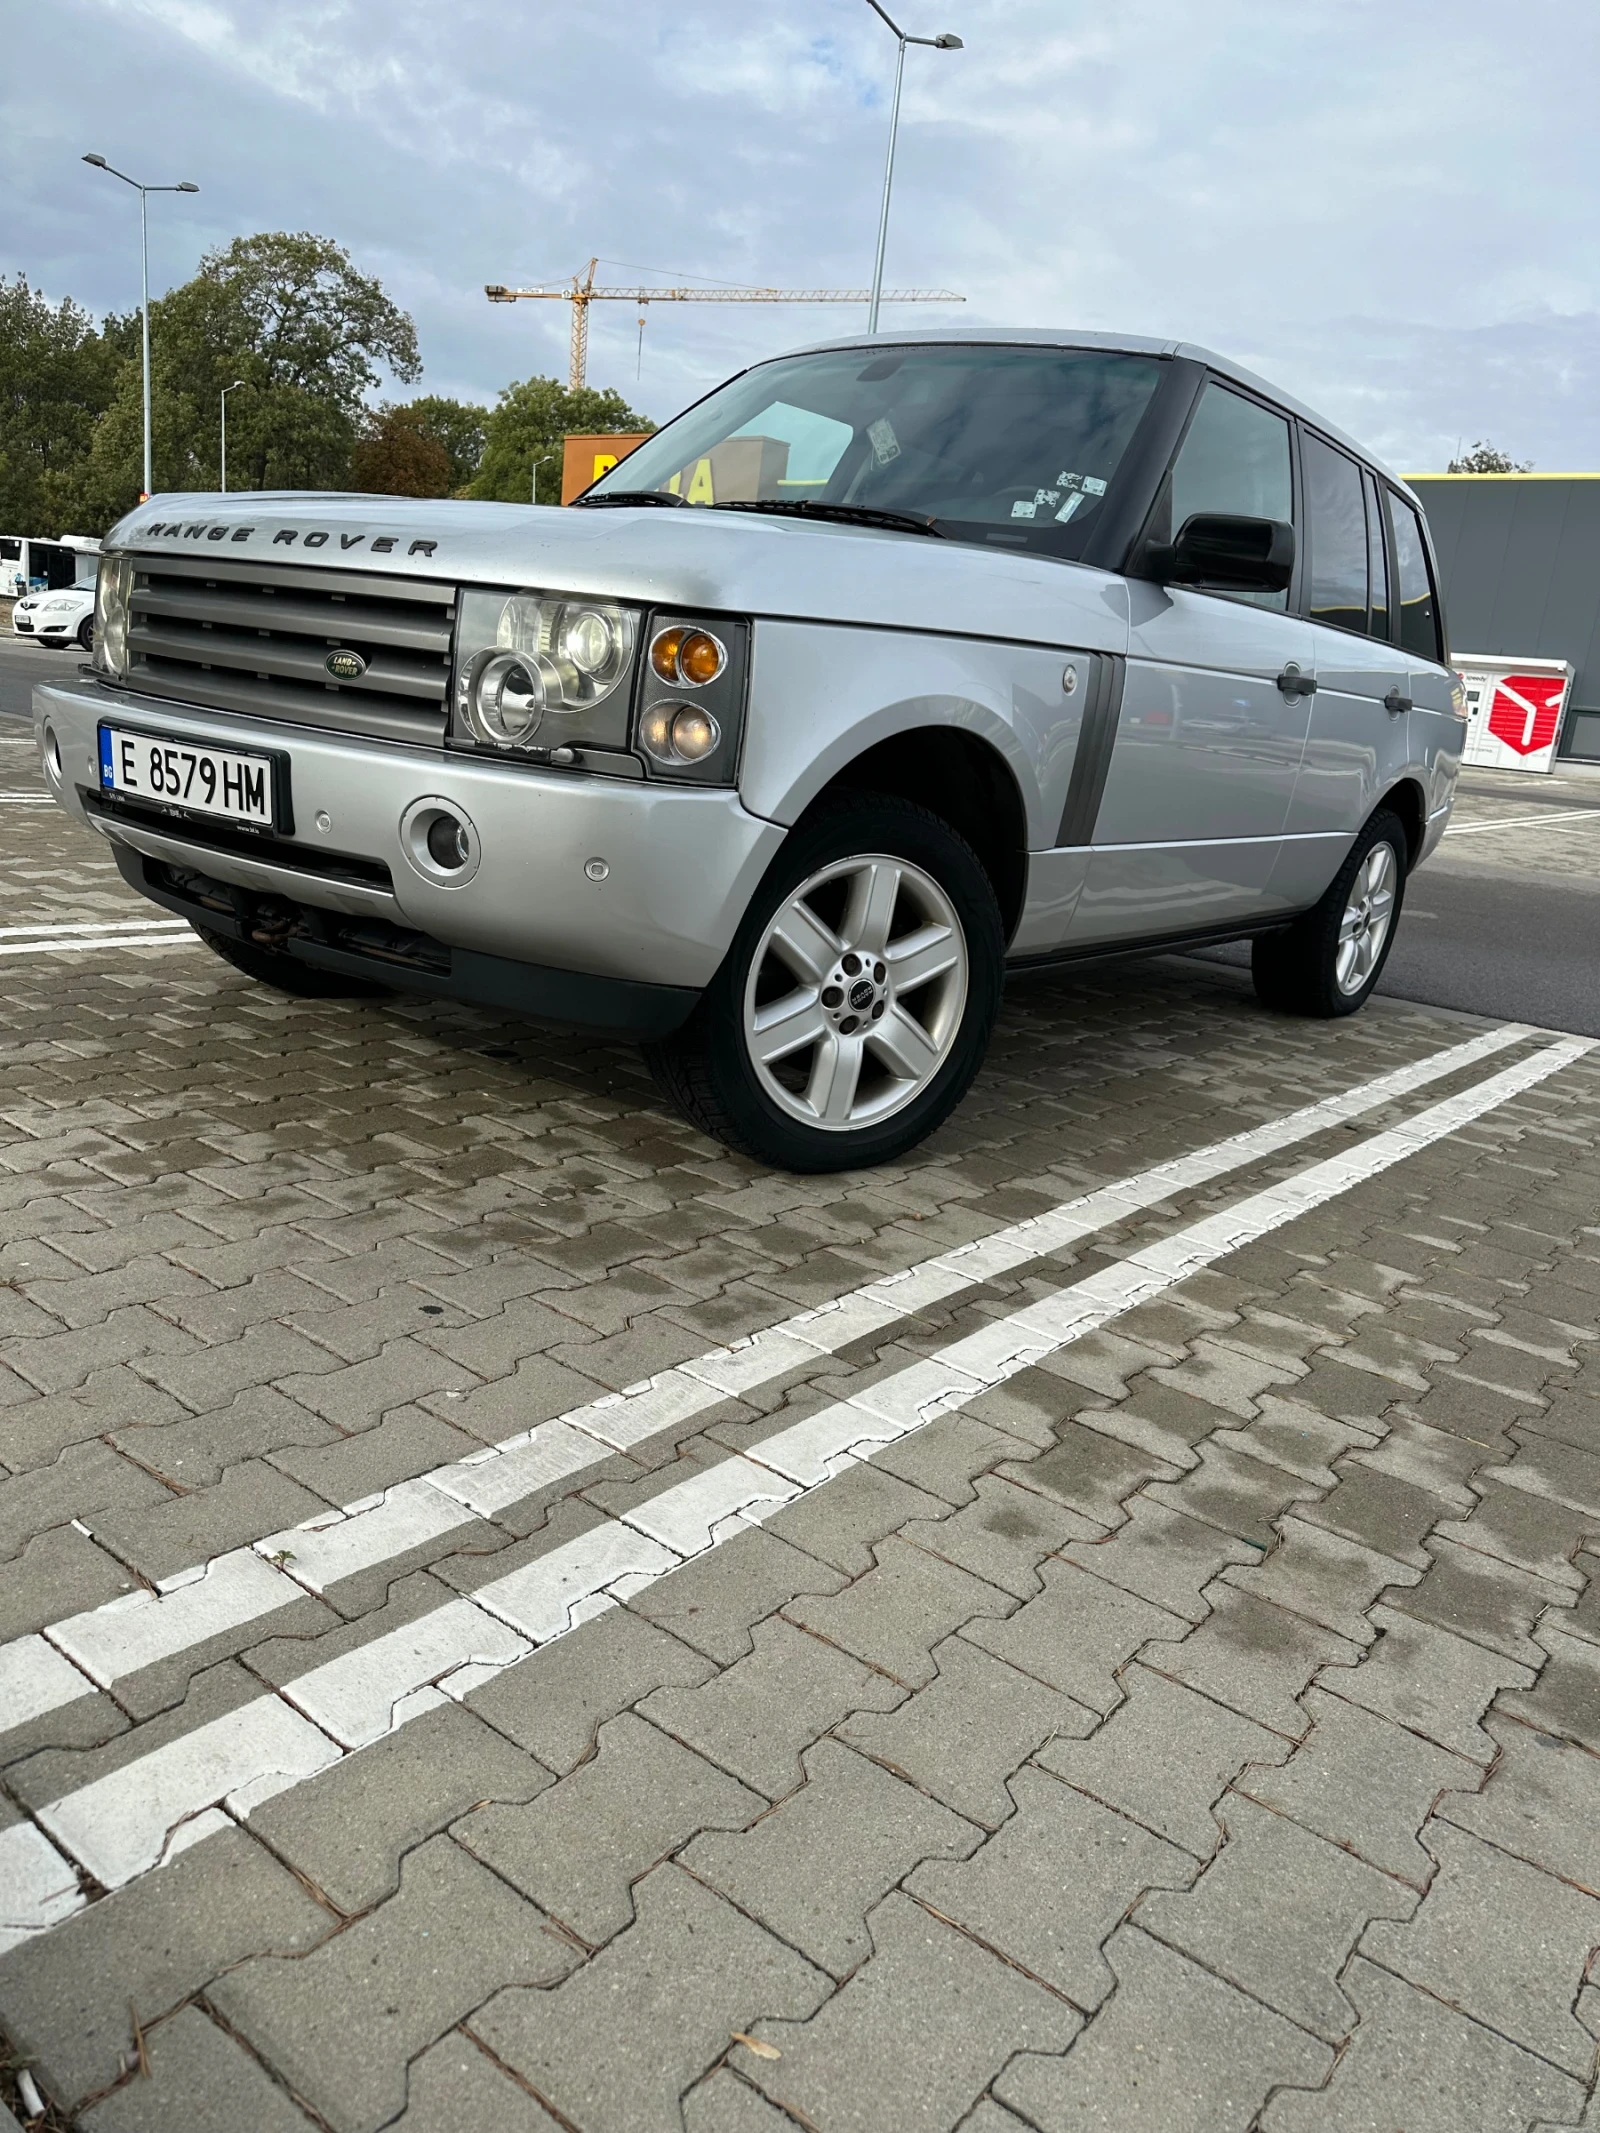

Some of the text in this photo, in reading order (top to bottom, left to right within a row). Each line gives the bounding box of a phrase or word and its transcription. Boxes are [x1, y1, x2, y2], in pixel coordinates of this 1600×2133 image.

[147, 523, 438, 557] RANGE ROVER
[333, 656, 353, 666] LAND
[335, 665, 358, 676] ROVER
[104, 764, 113, 779] BG
[121, 740, 266, 815] E 8579 HM
